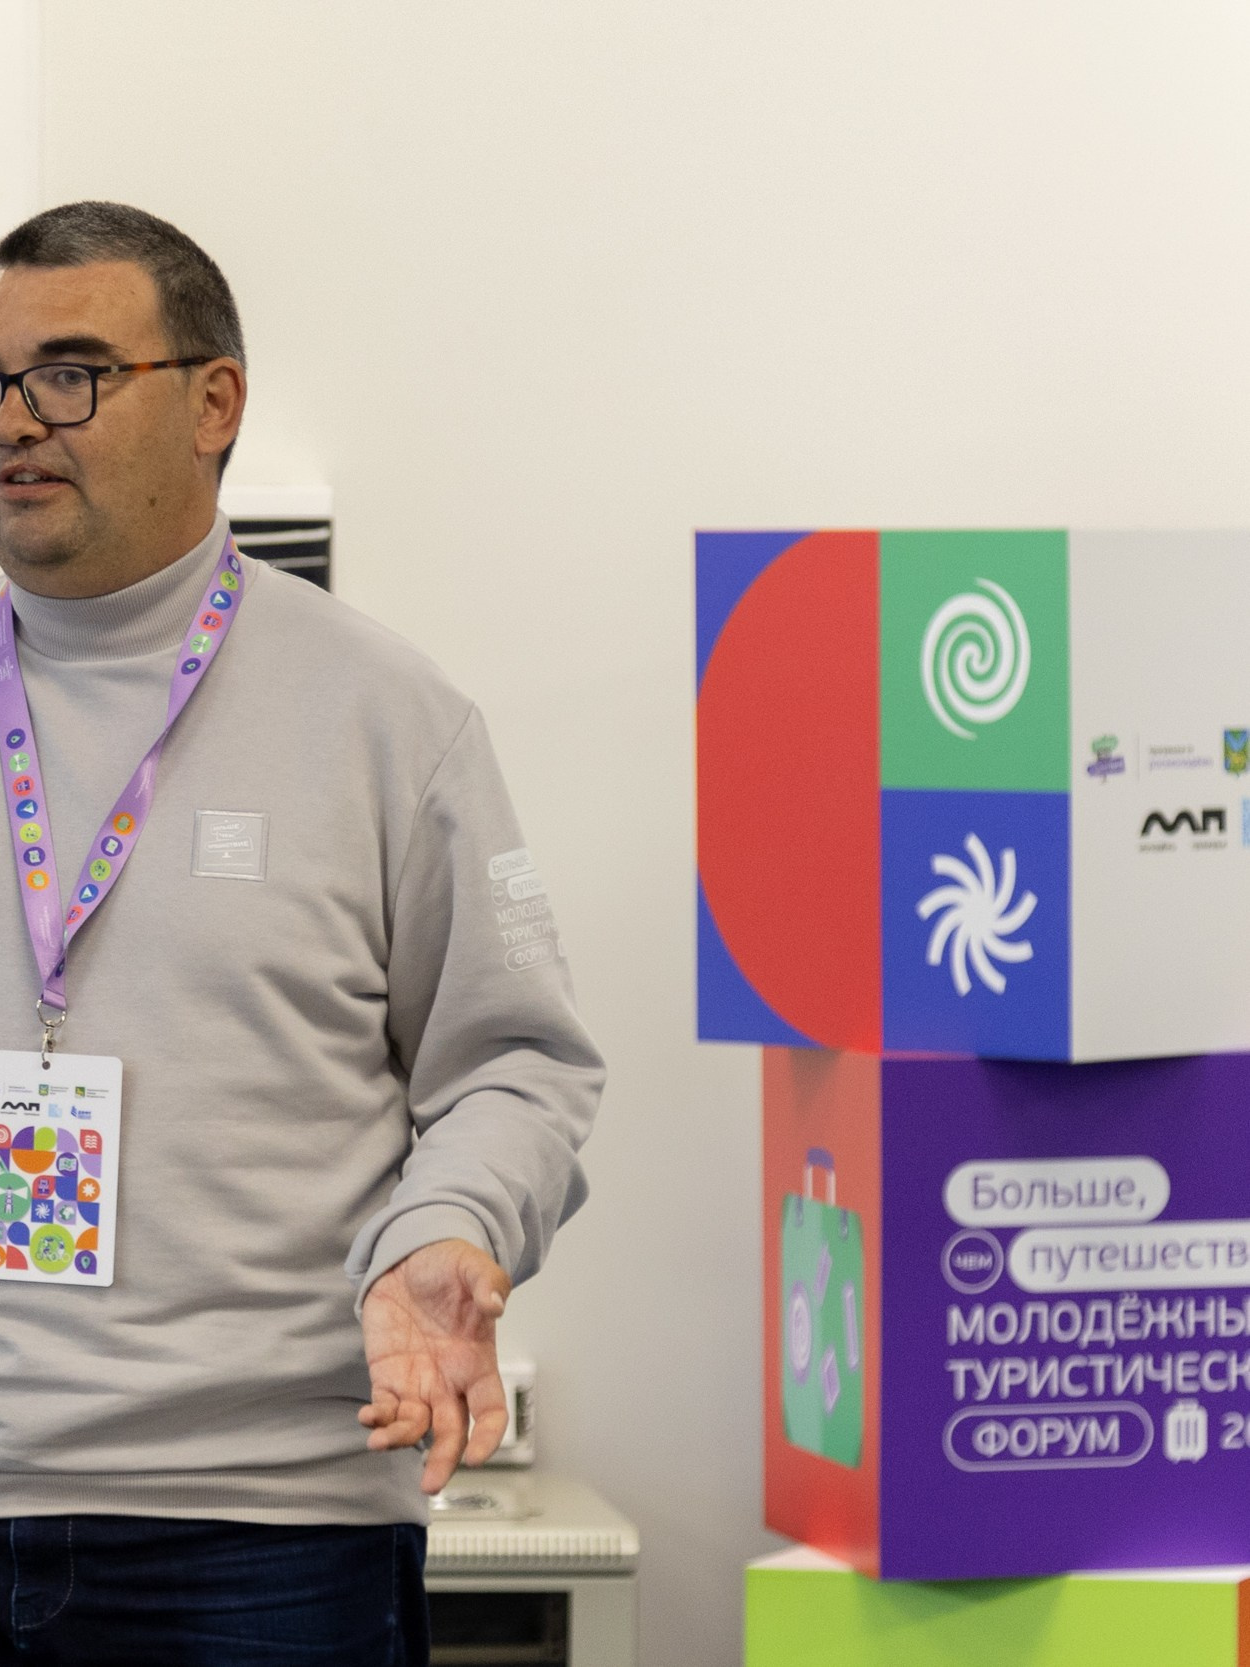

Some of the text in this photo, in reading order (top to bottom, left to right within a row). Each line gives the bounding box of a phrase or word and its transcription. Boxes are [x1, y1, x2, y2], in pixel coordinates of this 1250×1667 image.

[971, 1173, 1146, 1210] Больше,
[971, 1411, 1250, 1458] ФОРУМ 2
